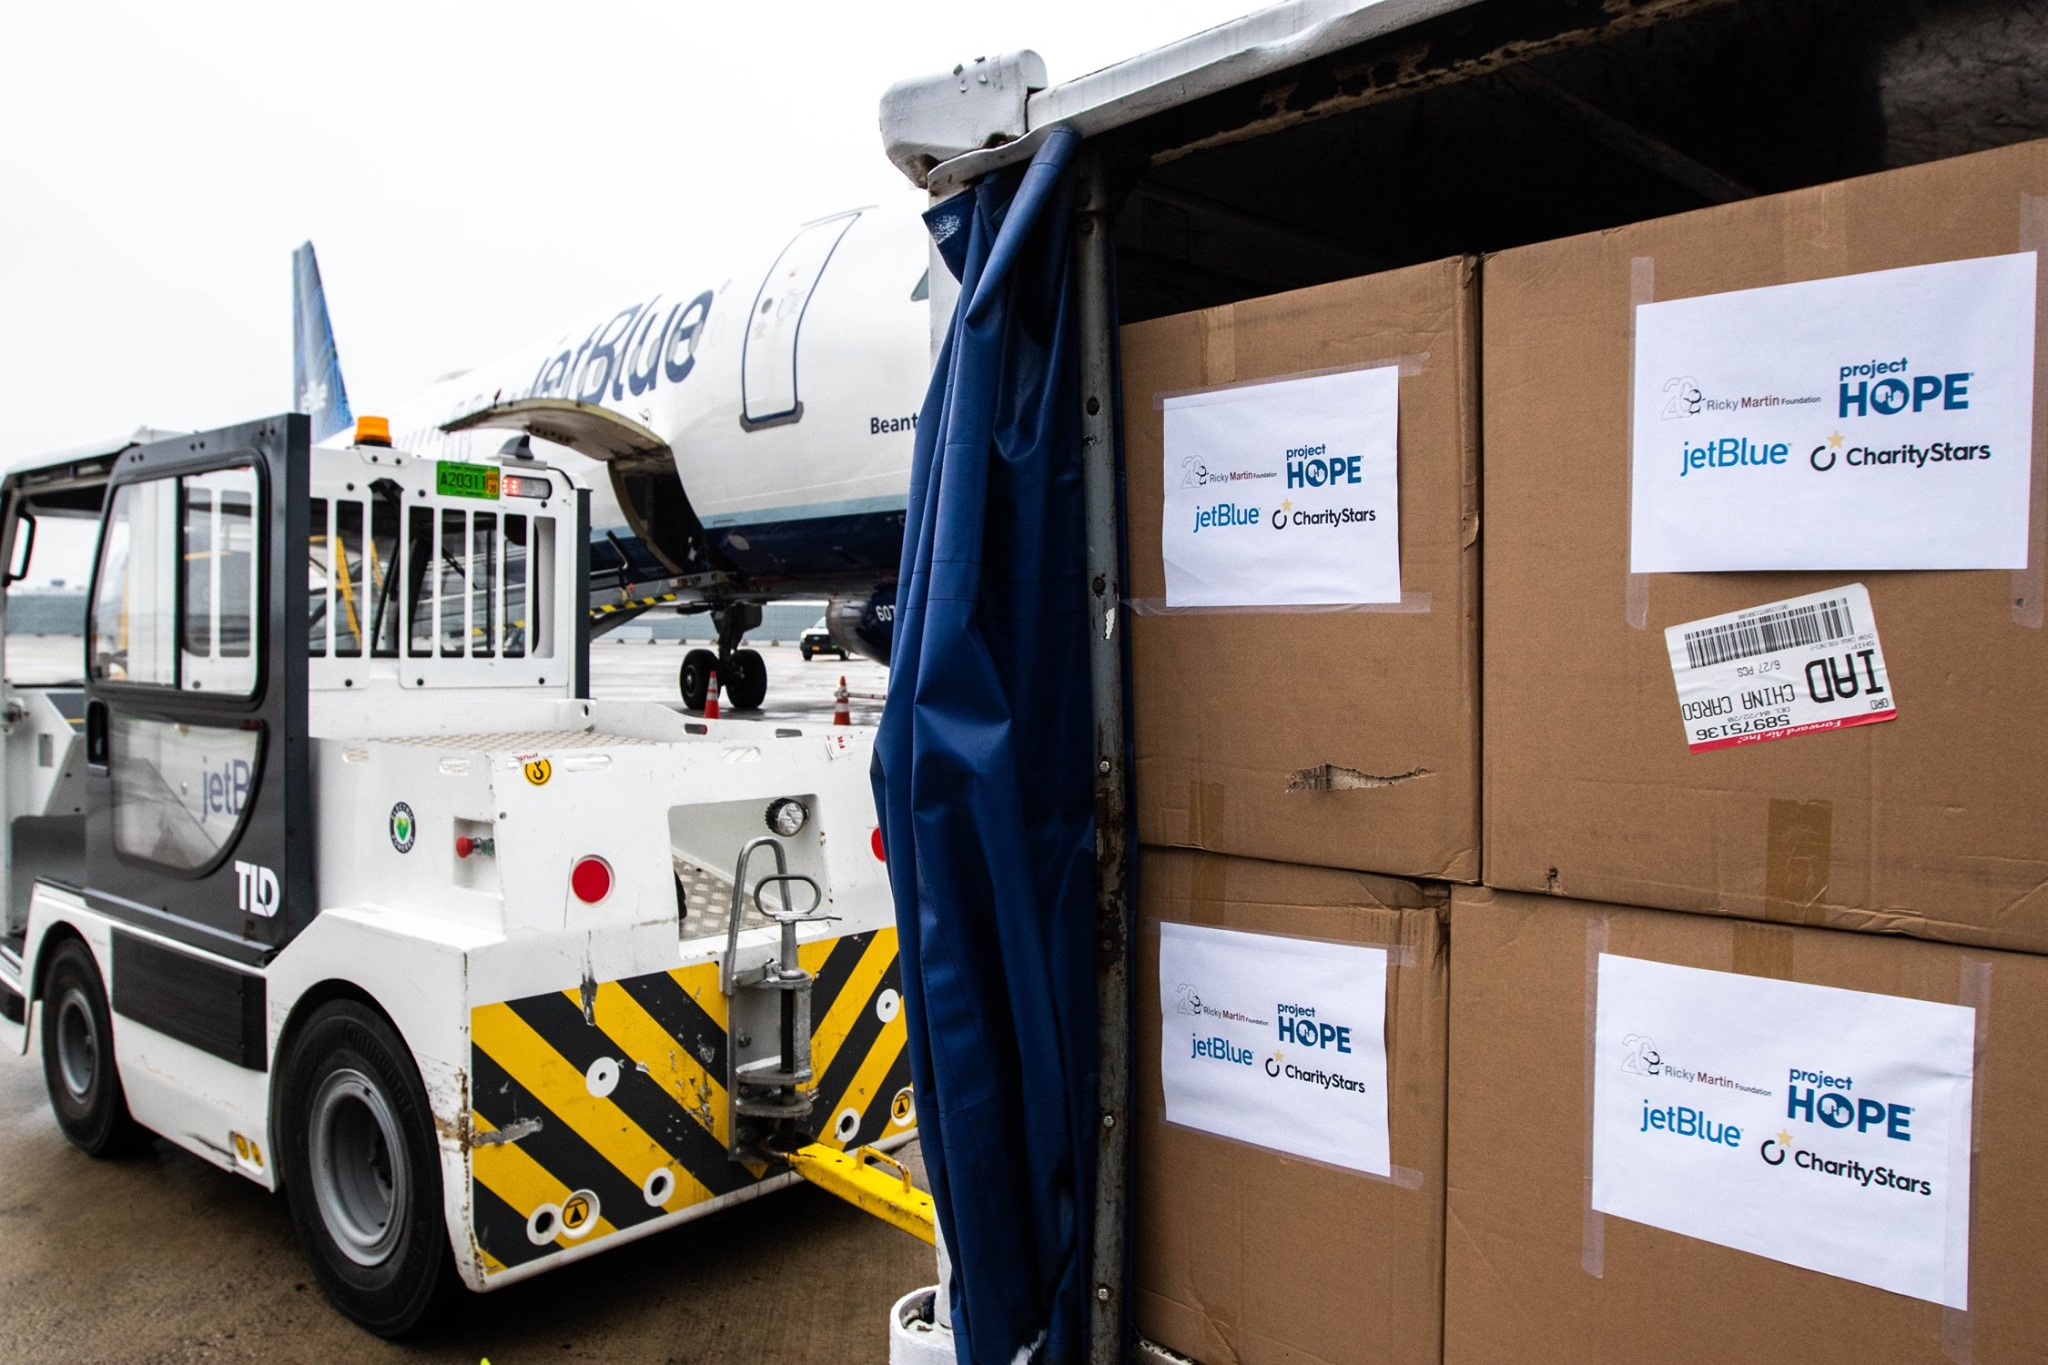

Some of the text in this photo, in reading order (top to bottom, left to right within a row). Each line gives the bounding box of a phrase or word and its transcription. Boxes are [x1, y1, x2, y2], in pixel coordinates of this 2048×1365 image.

[1840, 357, 1908, 381] project
[1707, 398, 1739, 412] Ricky
[1741, 395, 1780, 409] Martin
[1781, 396, 1821, 405] Foundation
[1839, 372, 1970, 419] HOPE
[870, 412, 918, 434] Beant
[1286, 443, 1327, 461] project
[1680, 437, 1789, 477] jetBlue
[1846, 441, 1992, 468] CharityStars
[1209, 473, 1228, 484] Ricky
[1229, 471, 1253, 481] Martin
[1287, 456, 1362, 489] HOPE
[1193, 503, 1260, 533] jetBlue
[1293, 508, 1376, 527] CharityStars
[1737, 660, 1781, 677] 6/27 PCS
[1805, 649, 1884, 704] IAD
[1682, 683, 1796, 721] CHINA CARGO
[1727, 706, 1791, 723] DEL 04/22/20
[1871, 698, 1889, 710] ORD
[1696, 714, 1790, 741] 58975136
[1786, 719, 1842, 736] Forward
[1203, 1006, 1222, 1019] Ricky
[1222, 1010, 1246, 1022] Martin
[1246, 1017, 1268, 1026] Foundation
[1277, 1003, 1316, 1018] project
[1278, 1016, 1352, 1054] HOPE
[1191, 1033, 1253, 1066] jetBlue
[1285, 1064, 1366, 1094] CharityStars
[1665, 1065, 1695, 1083] Ricky
[1697, 1071, 1734, 1088] Martin
[1735, 1083, 1772, 1096] Foundation
[1789, 1067, 1853, 1091] project
[1640, 1099, 1741, 1148] jetBlue
[1787, 1085, 1911, 1142] HOPE
[1794, 1150, 1932, 1196] CharityStars
